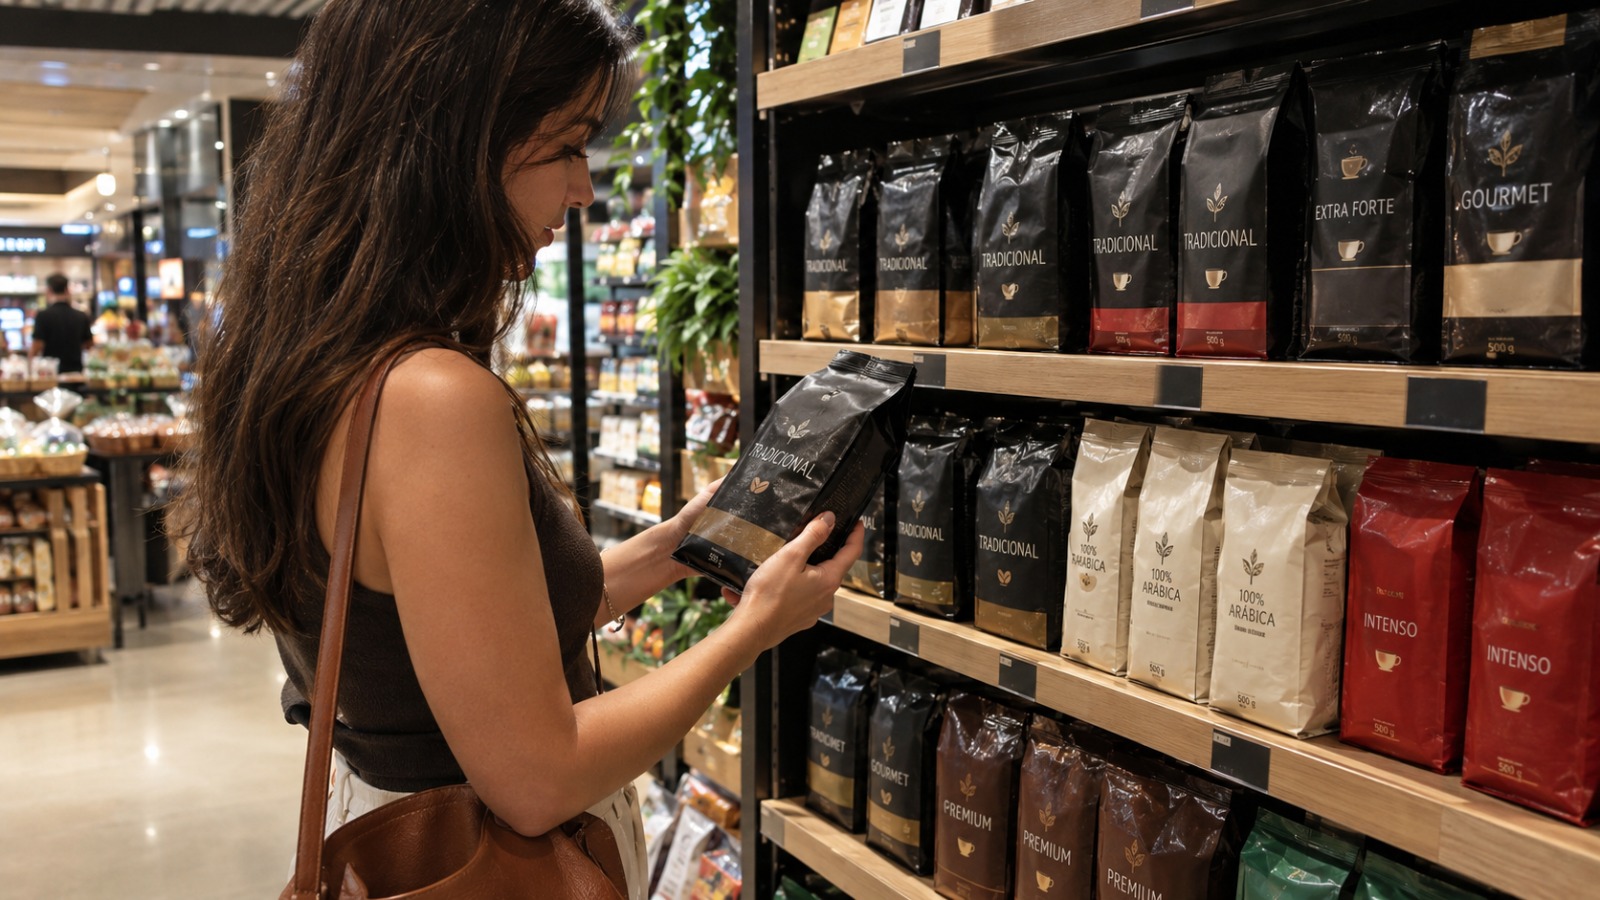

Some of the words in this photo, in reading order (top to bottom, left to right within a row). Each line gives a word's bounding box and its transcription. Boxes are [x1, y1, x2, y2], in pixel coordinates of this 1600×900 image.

[1462, 182, 1552, 210] GOURMET
[1315, 203, 1349, 221] EXTRA
[1353, 198, 1395, 216] FORTE
[1093, 235, 1158, 254] TRADICIONAL
[1184, 229, 1257, 250] TRADICIONAL
[879, 257, 927, 271] TRADICIONAL
[982, 249, 1046, 268] TRADICIONAL
[1206, 335, 1218, 344] 500
[1219, 338, 1225, 347] g
[1488, 342, 1506, 353] 500
[1507, 345, 1515, 355] g
[749, 443, 815, 480] TRADICIONAL
[899, 521, 944, 541] TRADICIONAL
[979, 534, 1039, 559] TRADICIONAL
[1152, 567, 1173, 584] 100%
[1239, 588, 1264, 606] 100%
[1364, 613, 1419, 637] INTENSO
[1487, 645, 1551, 674] INTENSO
[1237, 694, 1251, 705] 500
[870, 758, 909, 787] GOURMET
[943, 799, 992, 832] PREMIUM
[1023, 829, 1071, 866] PREMIUM
[1107, 868, 1162, 900] PREMIUM
